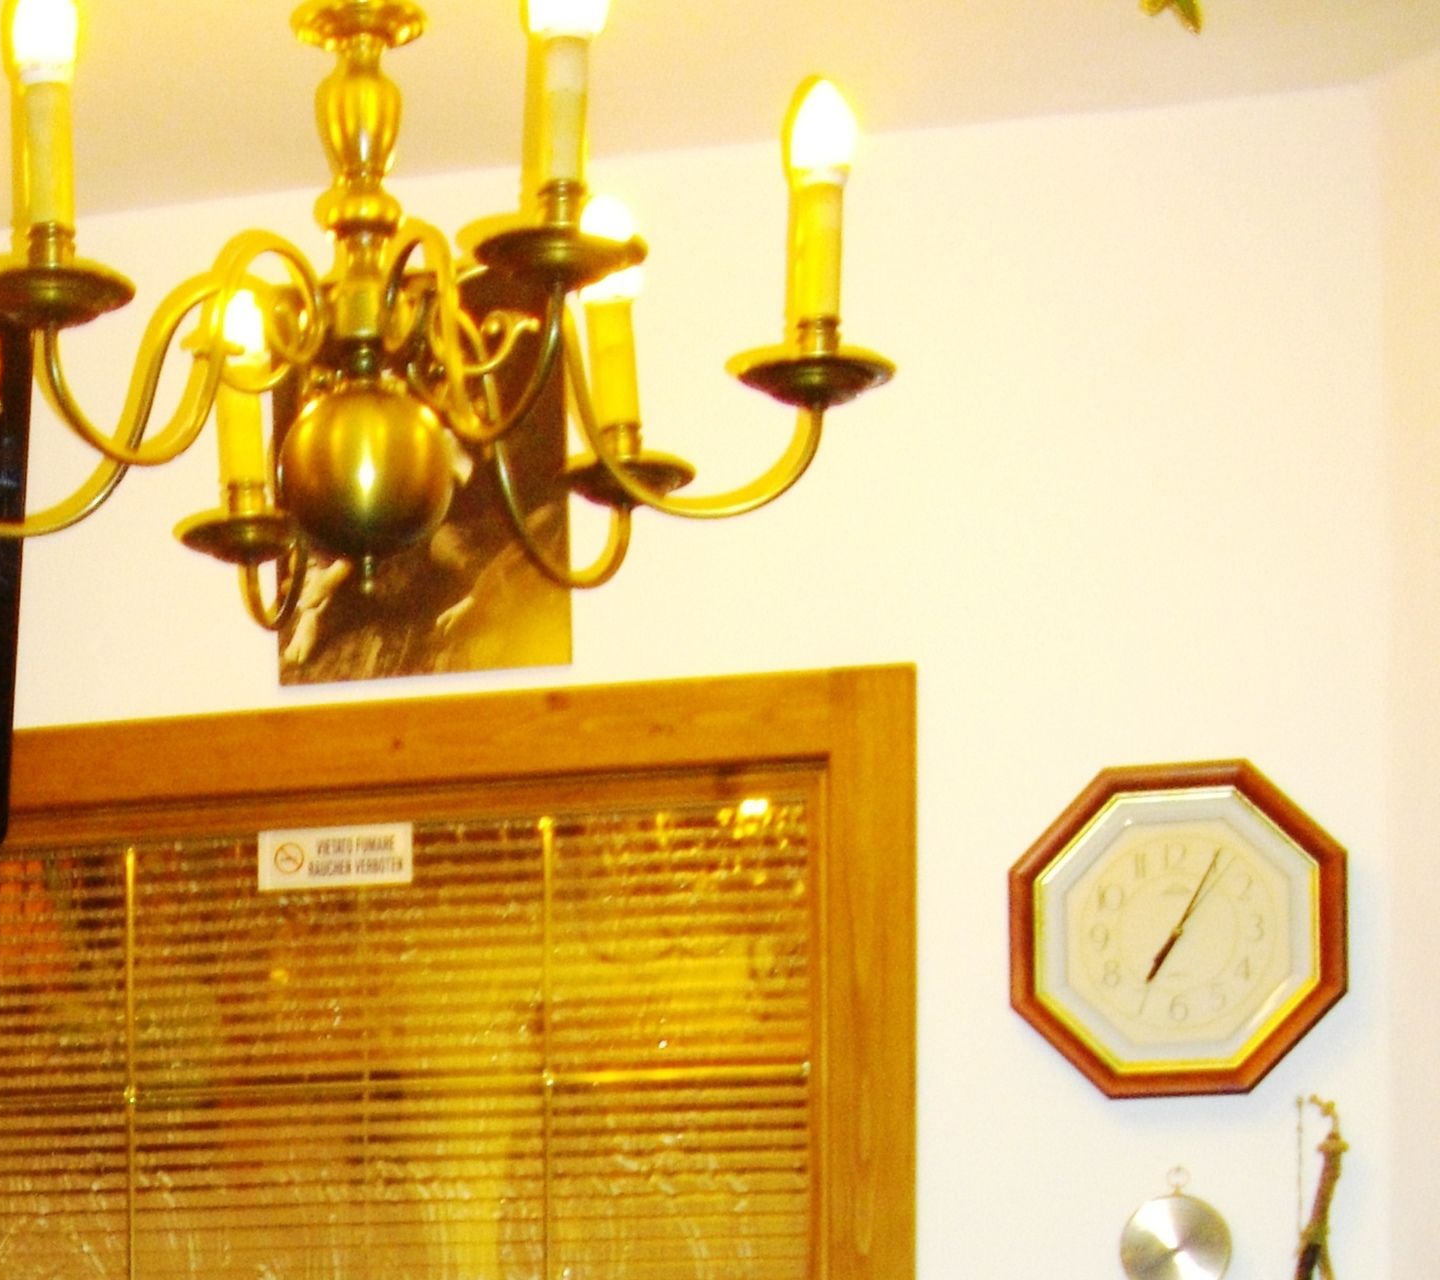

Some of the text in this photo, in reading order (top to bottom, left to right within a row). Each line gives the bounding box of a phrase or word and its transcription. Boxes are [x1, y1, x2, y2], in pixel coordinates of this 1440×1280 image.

[1134, 852, 1147, 879] 11
[1164, 842, 1187, 870] 12
[1097, 884, 1125, 911] 10
[1236, 874, 1253, 902] 2
[1089, 923, 1109, 951] 9
[1251, 914, 1265, 942] 3
[1103, 959, 1122, 988] 8
[1234, 958, 1251, 981] 4
[1169, 993, 1189, 1022] 6
[1211, 982, 1227, 1008] 5
